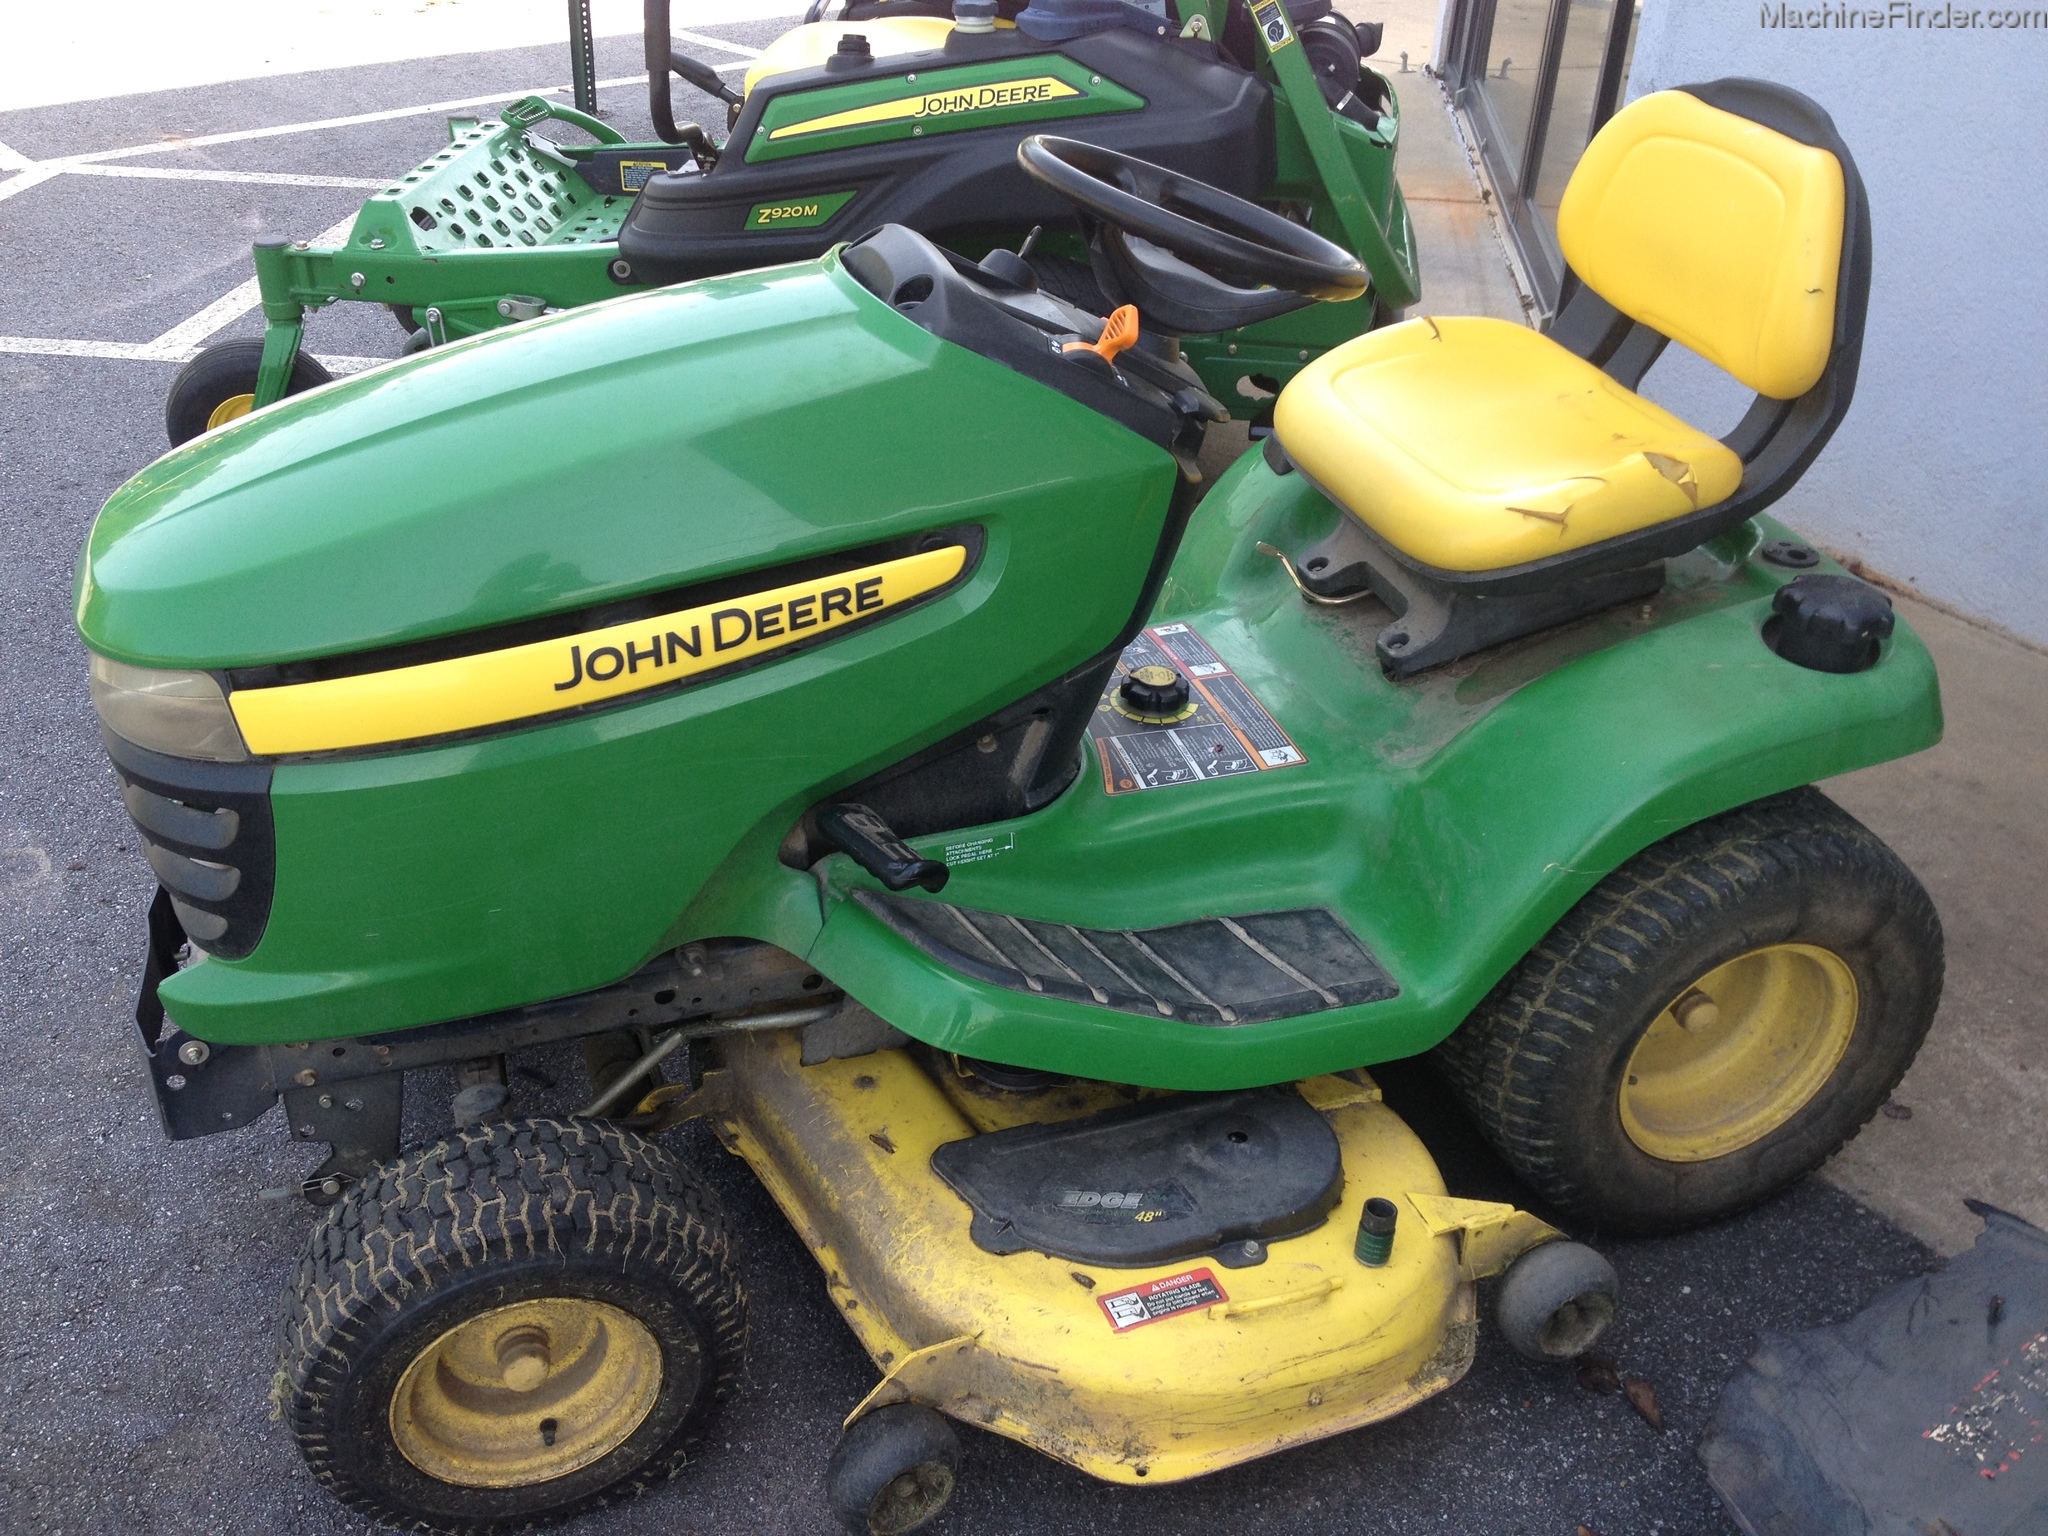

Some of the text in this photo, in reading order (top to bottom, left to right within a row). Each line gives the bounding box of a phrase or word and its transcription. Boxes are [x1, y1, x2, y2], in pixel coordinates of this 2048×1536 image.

[915, 84, 1051, 116] JOHN DEERE
[757, 204, 818, 224] Z920M
[554, 576, 884, 692] JOHN DEERE
[945, 845, 982, 856] ATTACHMENTS
[966, 838, 993, 846] CHANGING
[1057, 1190, 1143, 1209] EDGE
[1159, 1274, 1193, 1288] DANGER
[1148, 1282, 1202, 1301] ROTATING BLADE
